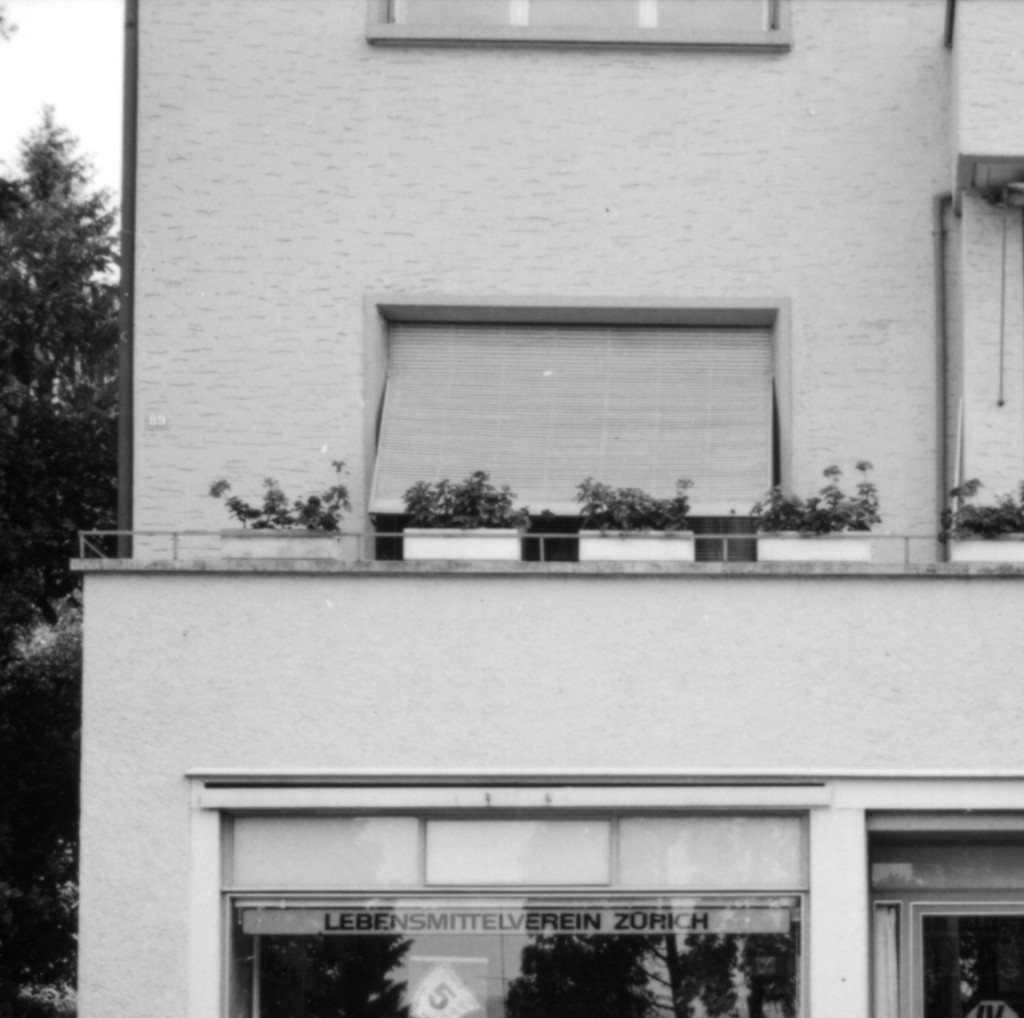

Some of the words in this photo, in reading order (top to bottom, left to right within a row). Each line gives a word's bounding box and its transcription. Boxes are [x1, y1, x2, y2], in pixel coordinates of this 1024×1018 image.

[324, 912, 601, 931] LEBENSMITTELVEREIN
[613, 911, 709, 930] ZÜRICH
[428, 982, 457, 1010] 5
